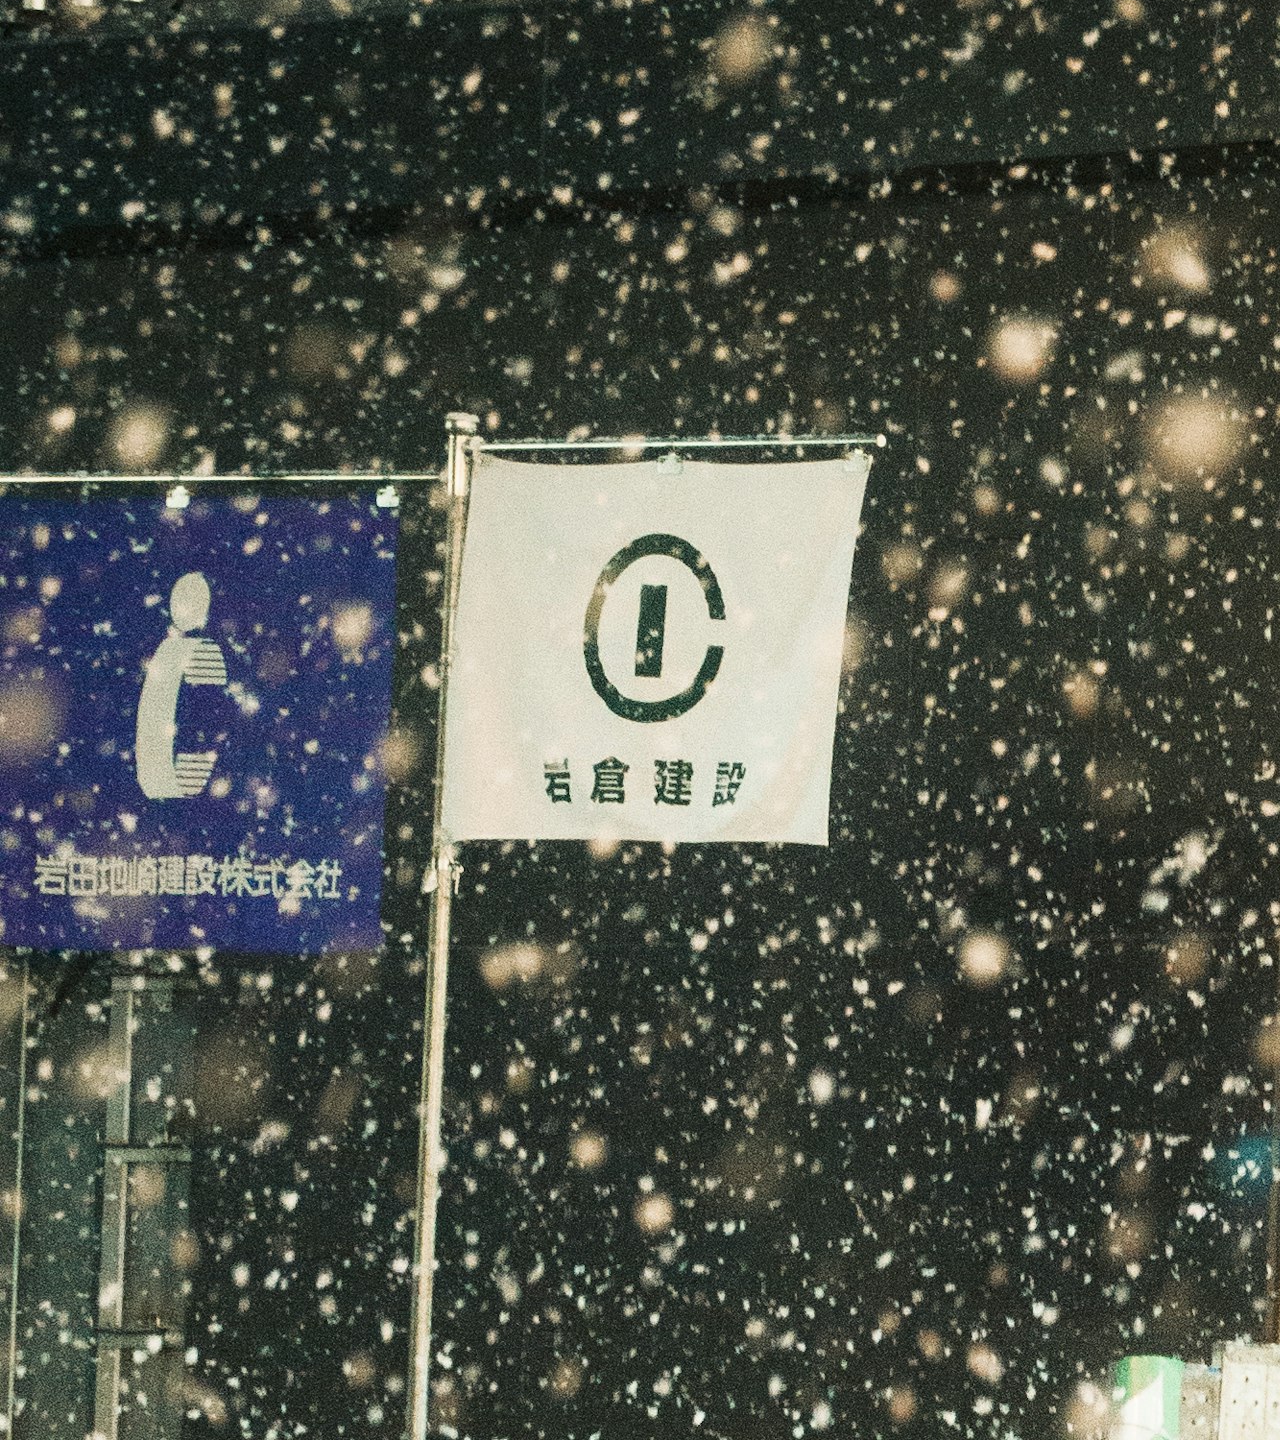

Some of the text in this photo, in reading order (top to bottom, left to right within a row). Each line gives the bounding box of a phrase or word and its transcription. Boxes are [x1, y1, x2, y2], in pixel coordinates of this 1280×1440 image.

[543, 755, 746, 807] 岩倉建設
[33, 853, 343, 900] 岩田地崎建設株式会社
